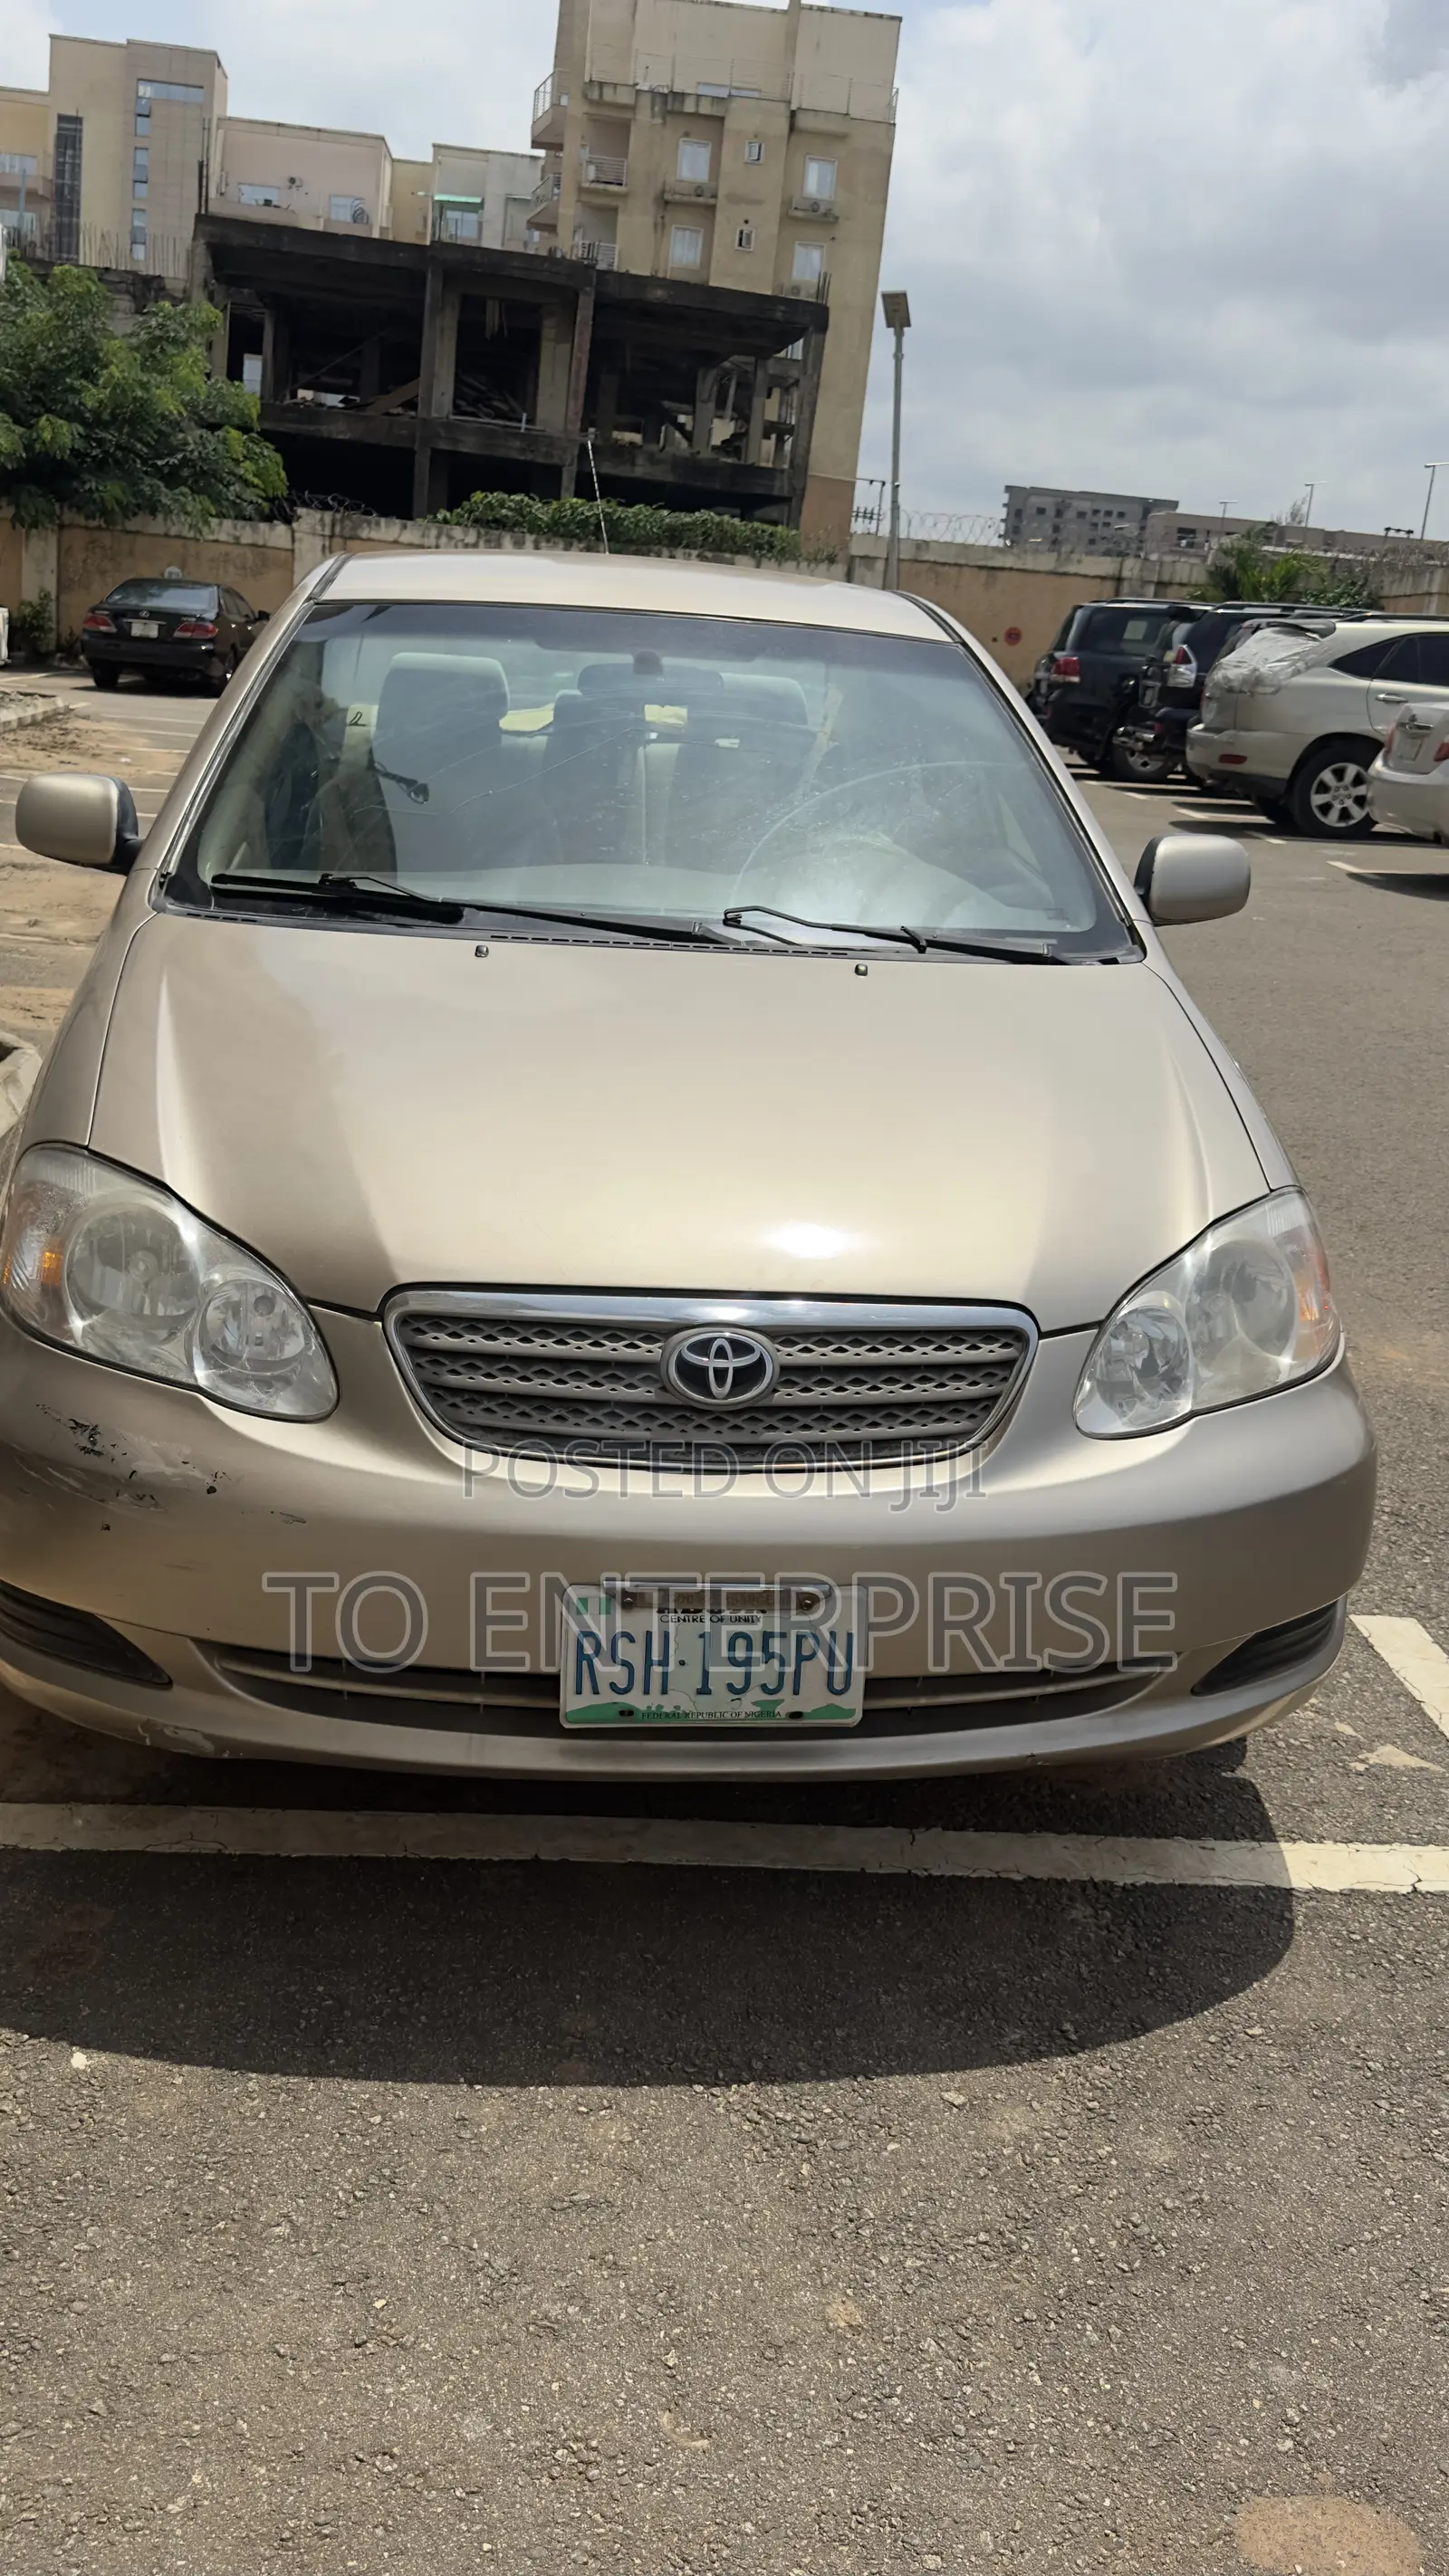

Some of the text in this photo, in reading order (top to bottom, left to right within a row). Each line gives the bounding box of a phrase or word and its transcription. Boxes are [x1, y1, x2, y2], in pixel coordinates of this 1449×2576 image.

[659, 1614, 762, 1623] CENTRE OF UNITY
[641, 1709, 782, 1719] FEDERAL REPUBLIC OF NIGERIA
